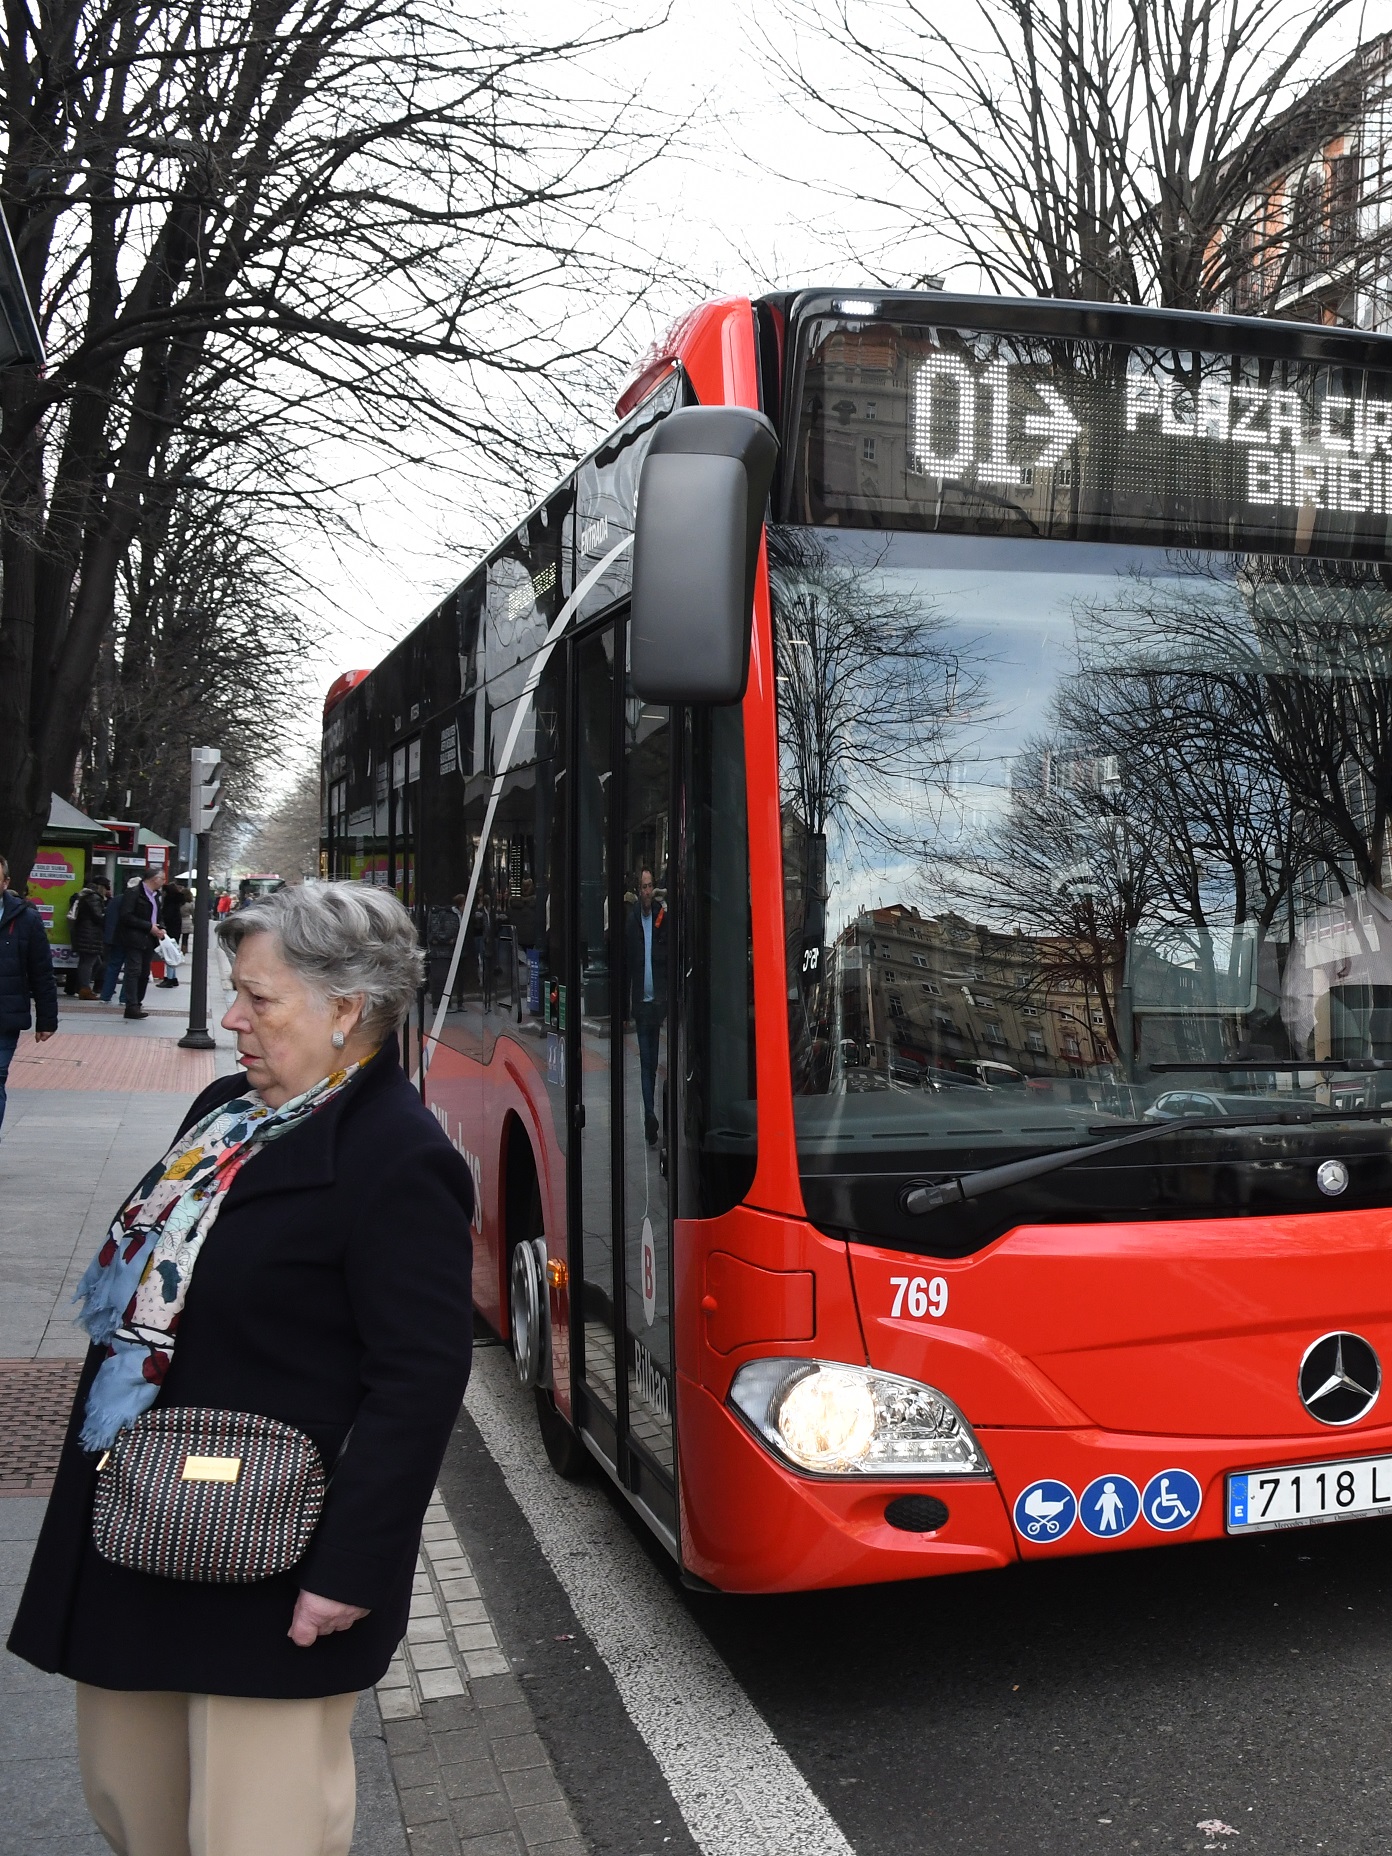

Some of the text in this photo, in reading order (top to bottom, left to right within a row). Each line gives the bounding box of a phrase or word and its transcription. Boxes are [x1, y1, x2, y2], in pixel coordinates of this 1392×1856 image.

[915, 353, 1022, 484] 01
[1126, 375, 1302, 446] PLAZA
[581, 515, 608, 557] ENTRADA
[889, 1276, 949, 1318] 769
[635, 1339, 669, 1421] Bilbao
[1234, 1505, 1244, 1518] E
[1259, 1470, 1356, 1518] 7118
